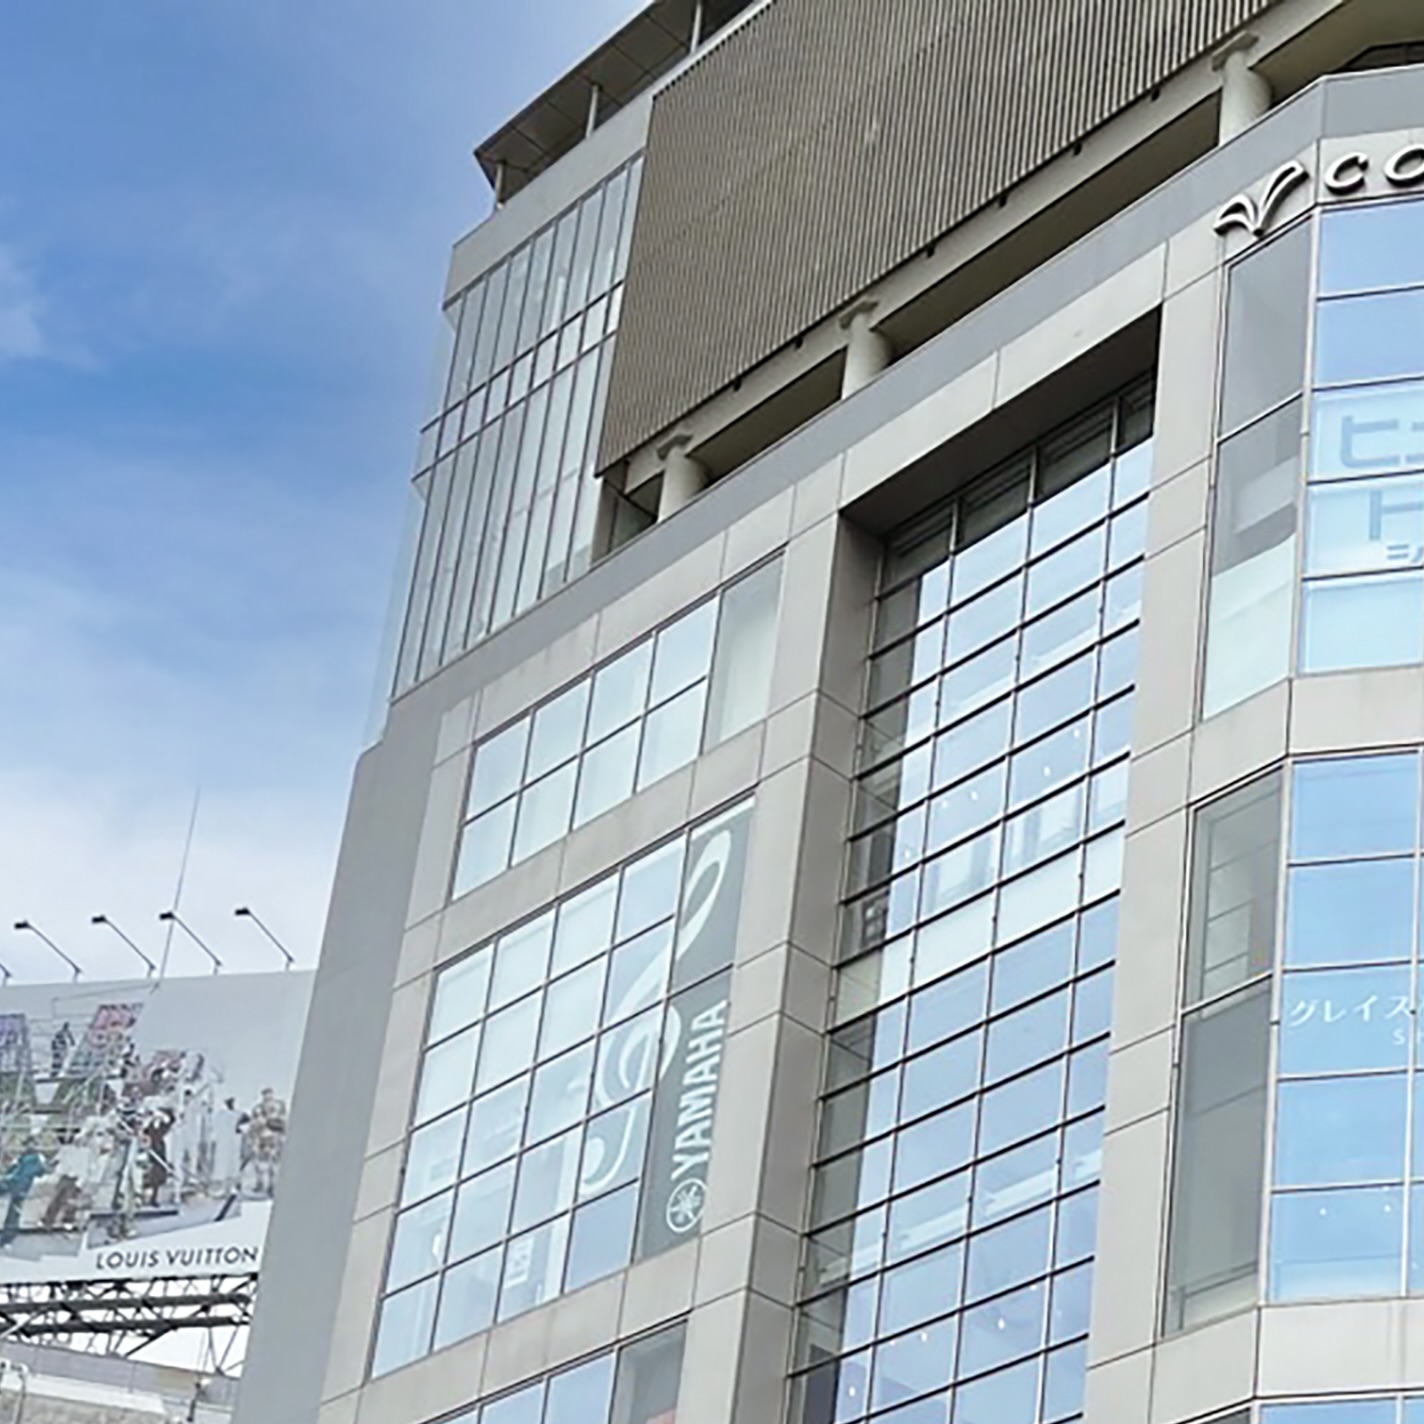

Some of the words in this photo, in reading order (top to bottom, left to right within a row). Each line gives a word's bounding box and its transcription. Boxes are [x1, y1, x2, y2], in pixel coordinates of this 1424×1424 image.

[671, 1000, 728, 1180] YAMAHA
[96, 1250, 159, 1270] LOUIS
[167, 1247, 258, 1266] VUITTON
